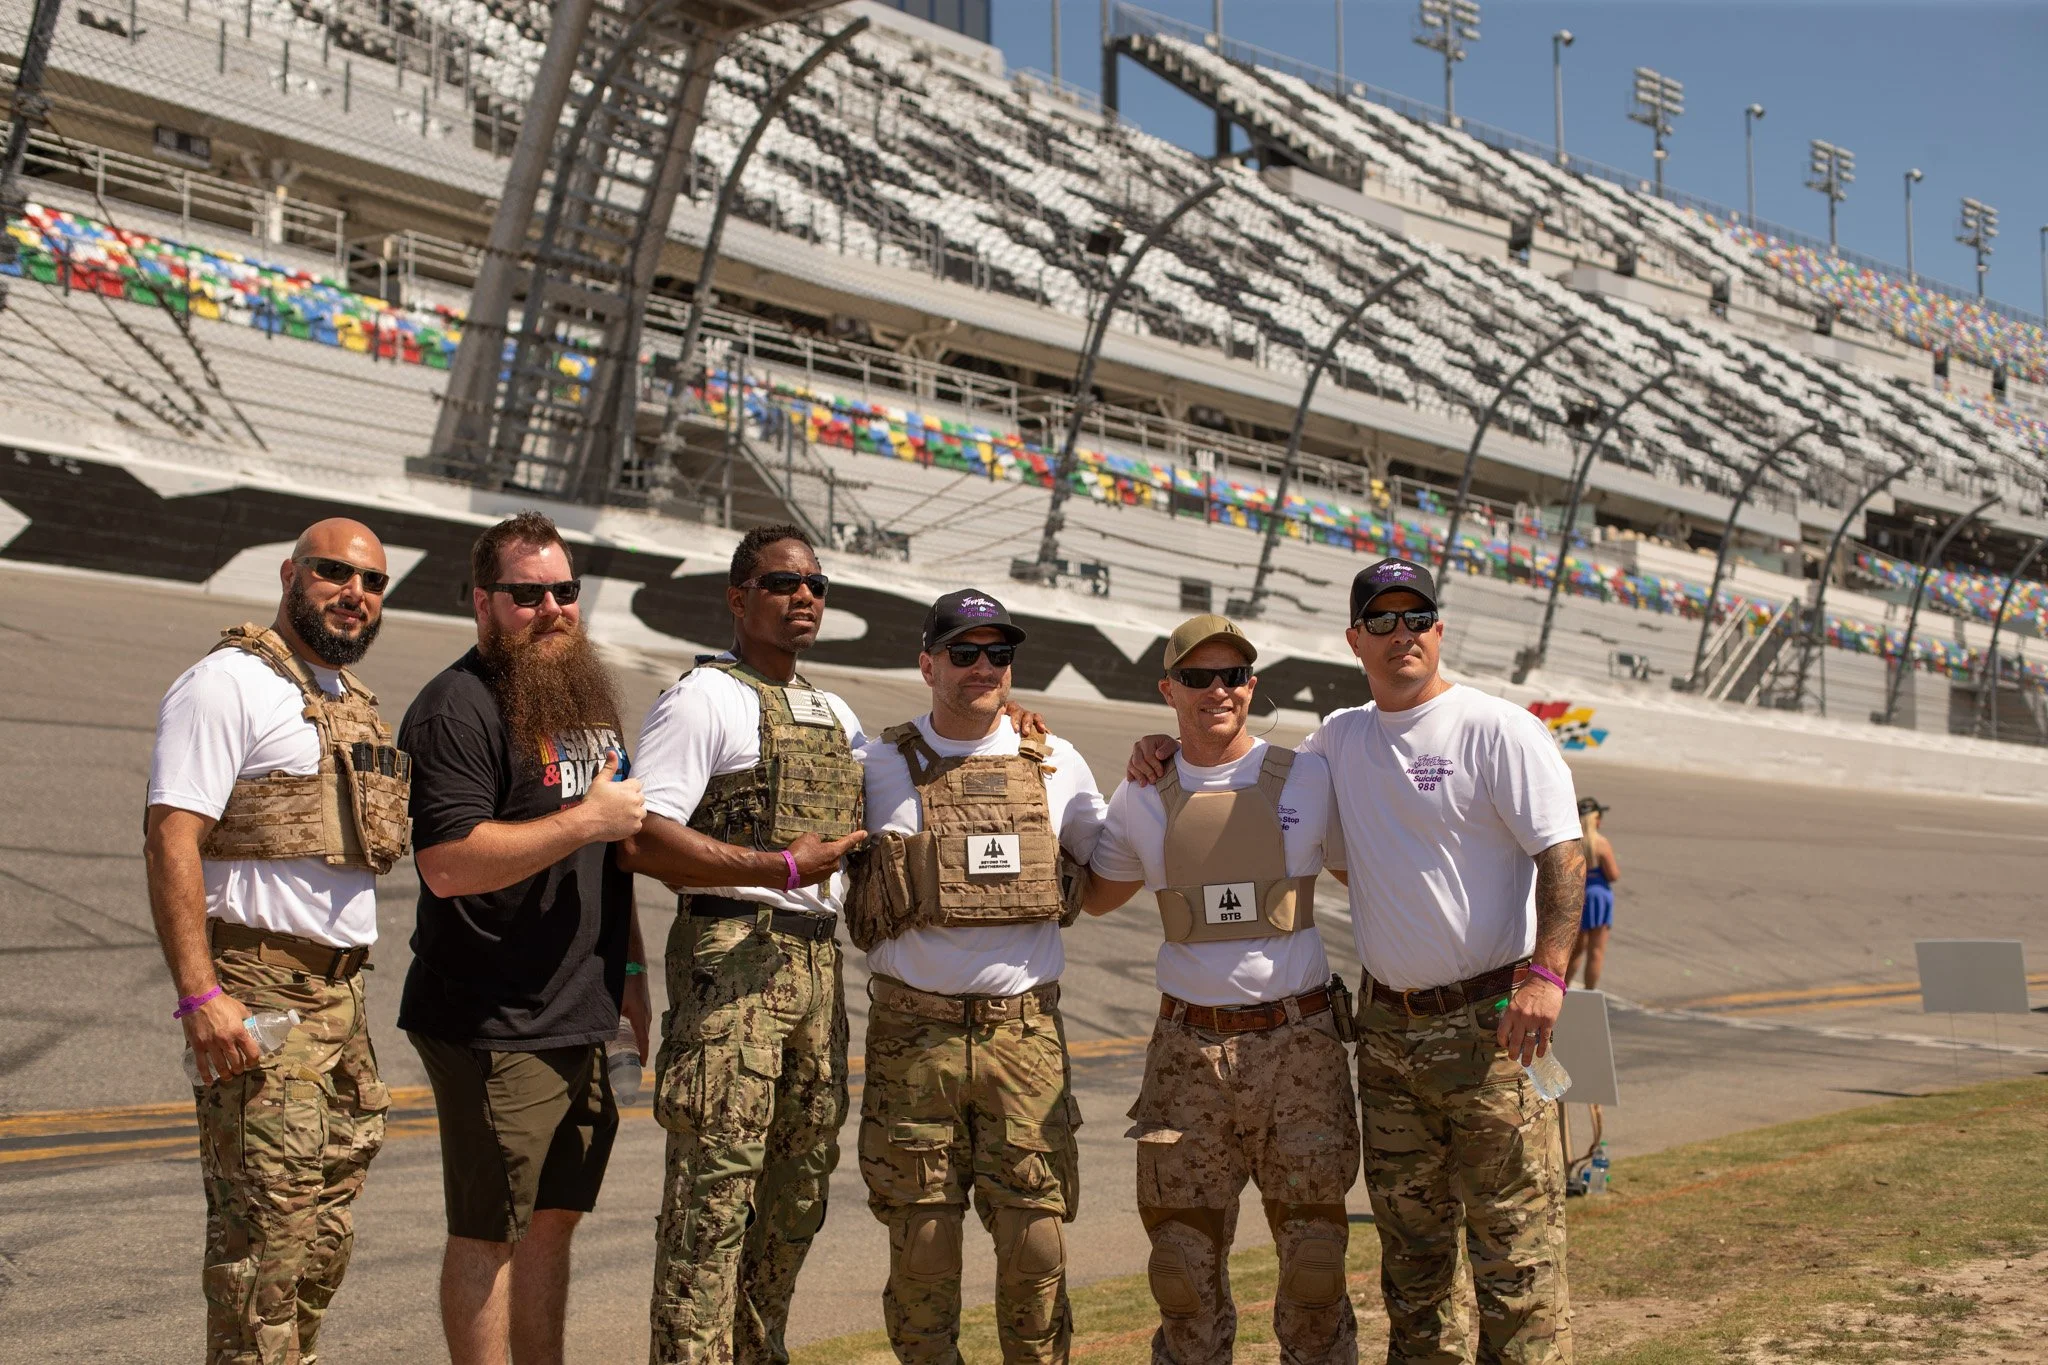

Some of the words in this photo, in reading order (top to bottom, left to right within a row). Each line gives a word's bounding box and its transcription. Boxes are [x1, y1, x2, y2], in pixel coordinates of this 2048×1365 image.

[1436, 768, 1454, 776] Stop
[543, 764, 561, 787] &
[559, 759, 607, 798] BAK
[1417, 783, 1436, 791] 988
[1282, 816, 1300, 825] Stop
[1220, 912, 1242, 921] BTB
